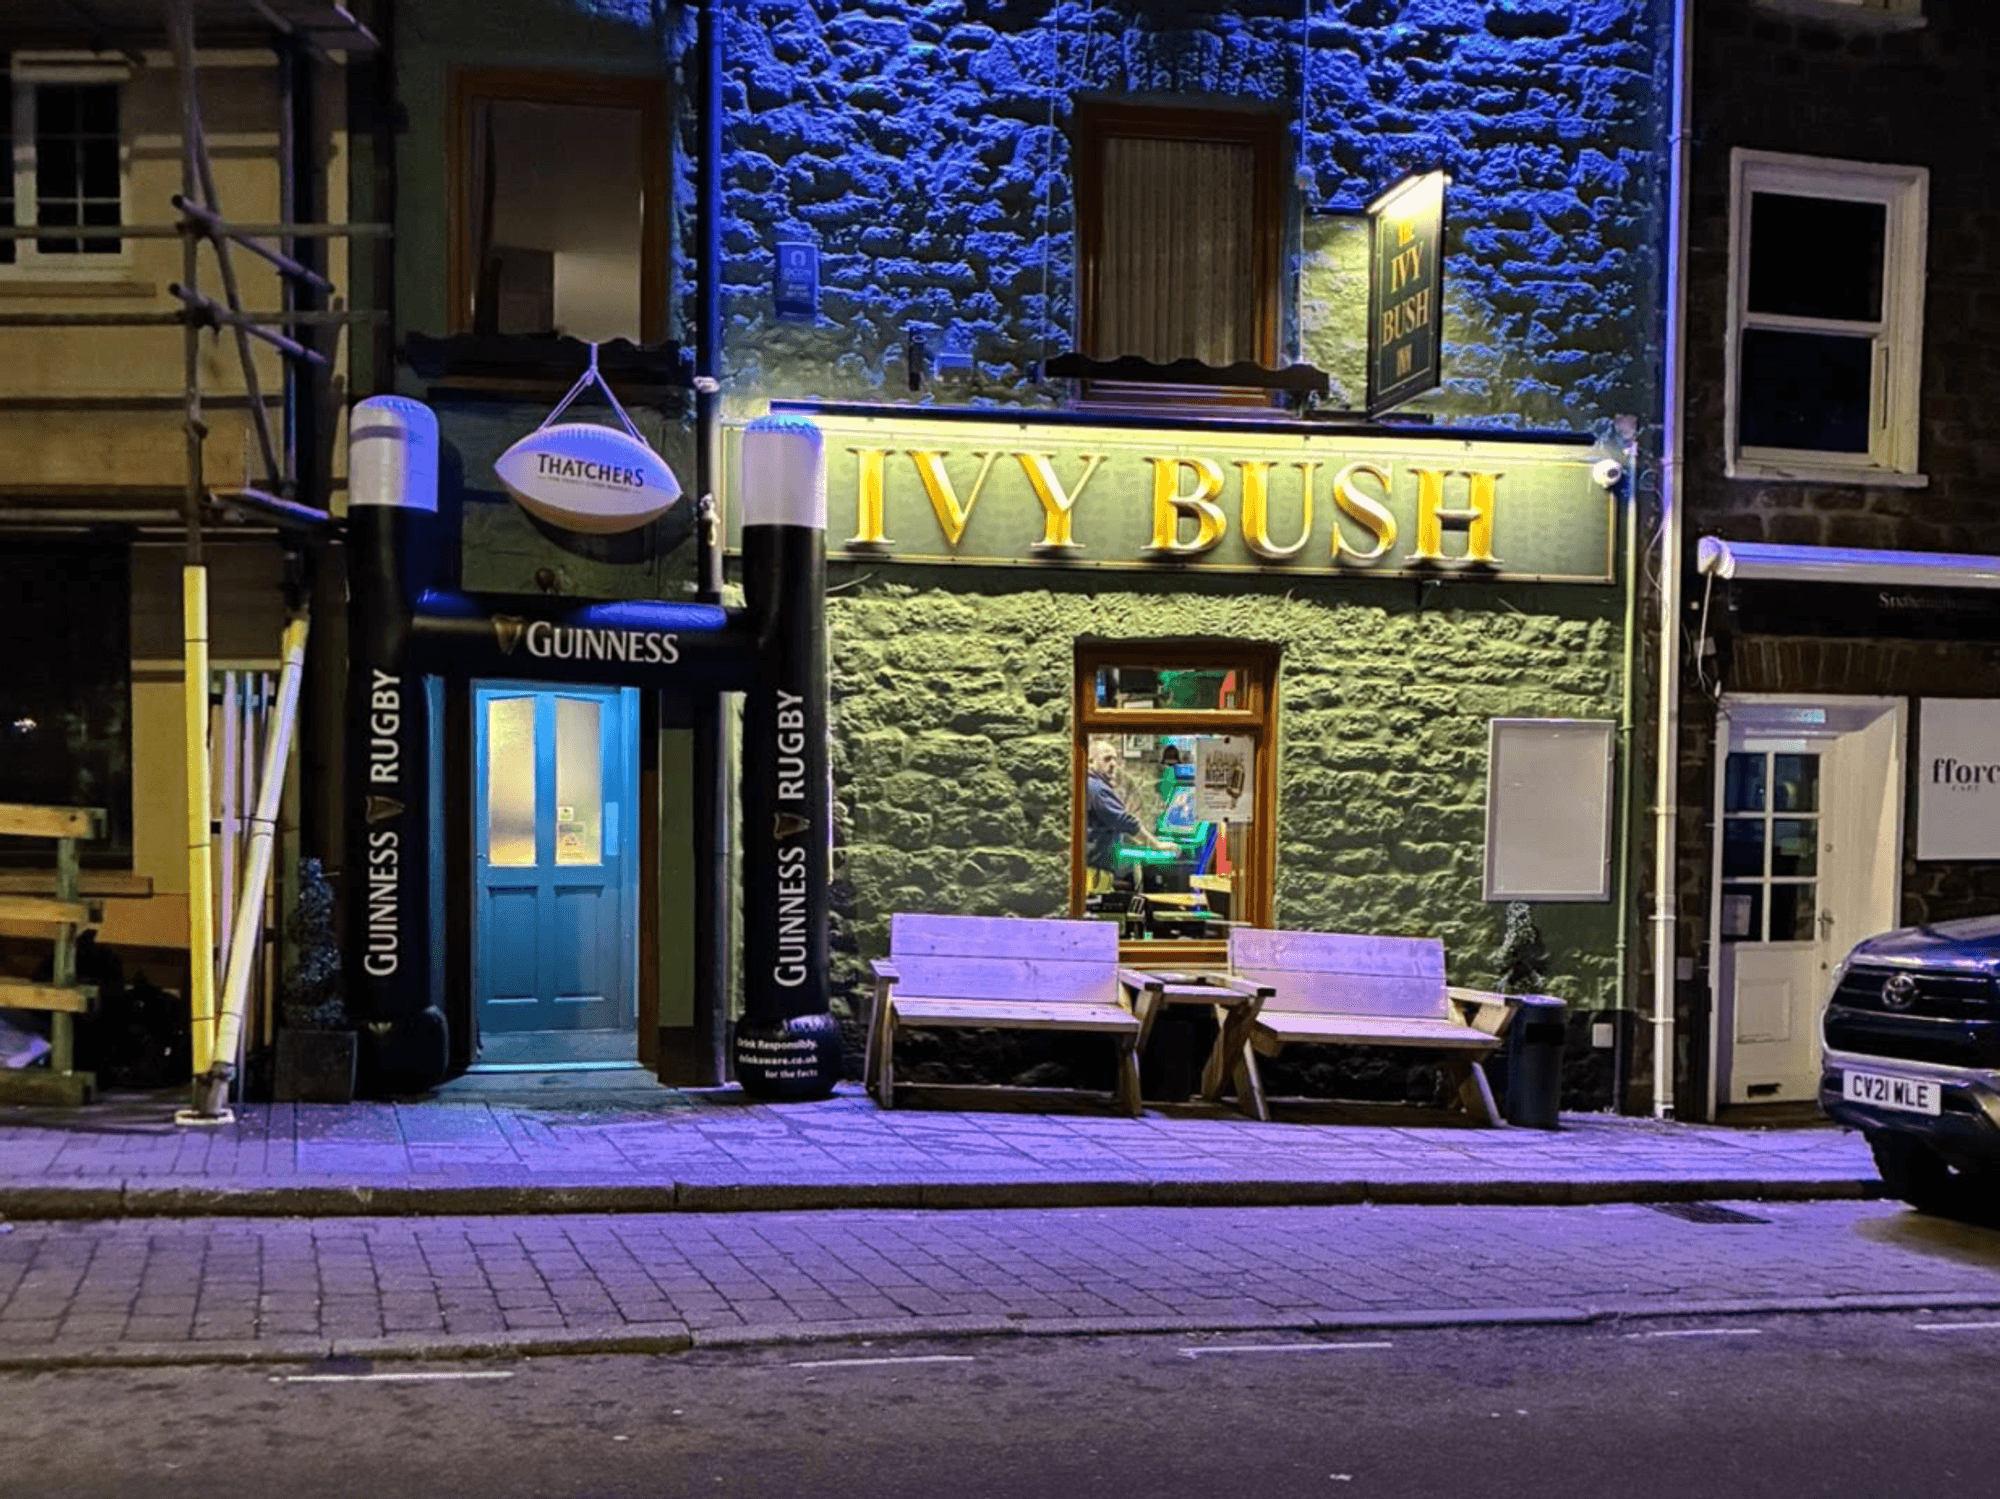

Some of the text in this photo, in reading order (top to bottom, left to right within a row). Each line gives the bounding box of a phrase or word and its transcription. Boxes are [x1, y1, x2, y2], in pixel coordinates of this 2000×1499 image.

[1391, 241, 1424, 293] IVY
[1382, 287, 1431, 347] BUSH
[537, 453, 645, 488] THATCHERS
[845, 446, 1506, 568] IVY BUSH
[526, 620, 680, 664] GUINNESS
[364, 668, 401, 977] GUINNESS RUGBY
[773, 689, 807, 988] GUINNESS RUGBY
[780, 1069, 795, 1078] the
[1853, 1075, 1929, 1108] CV21 WLE
